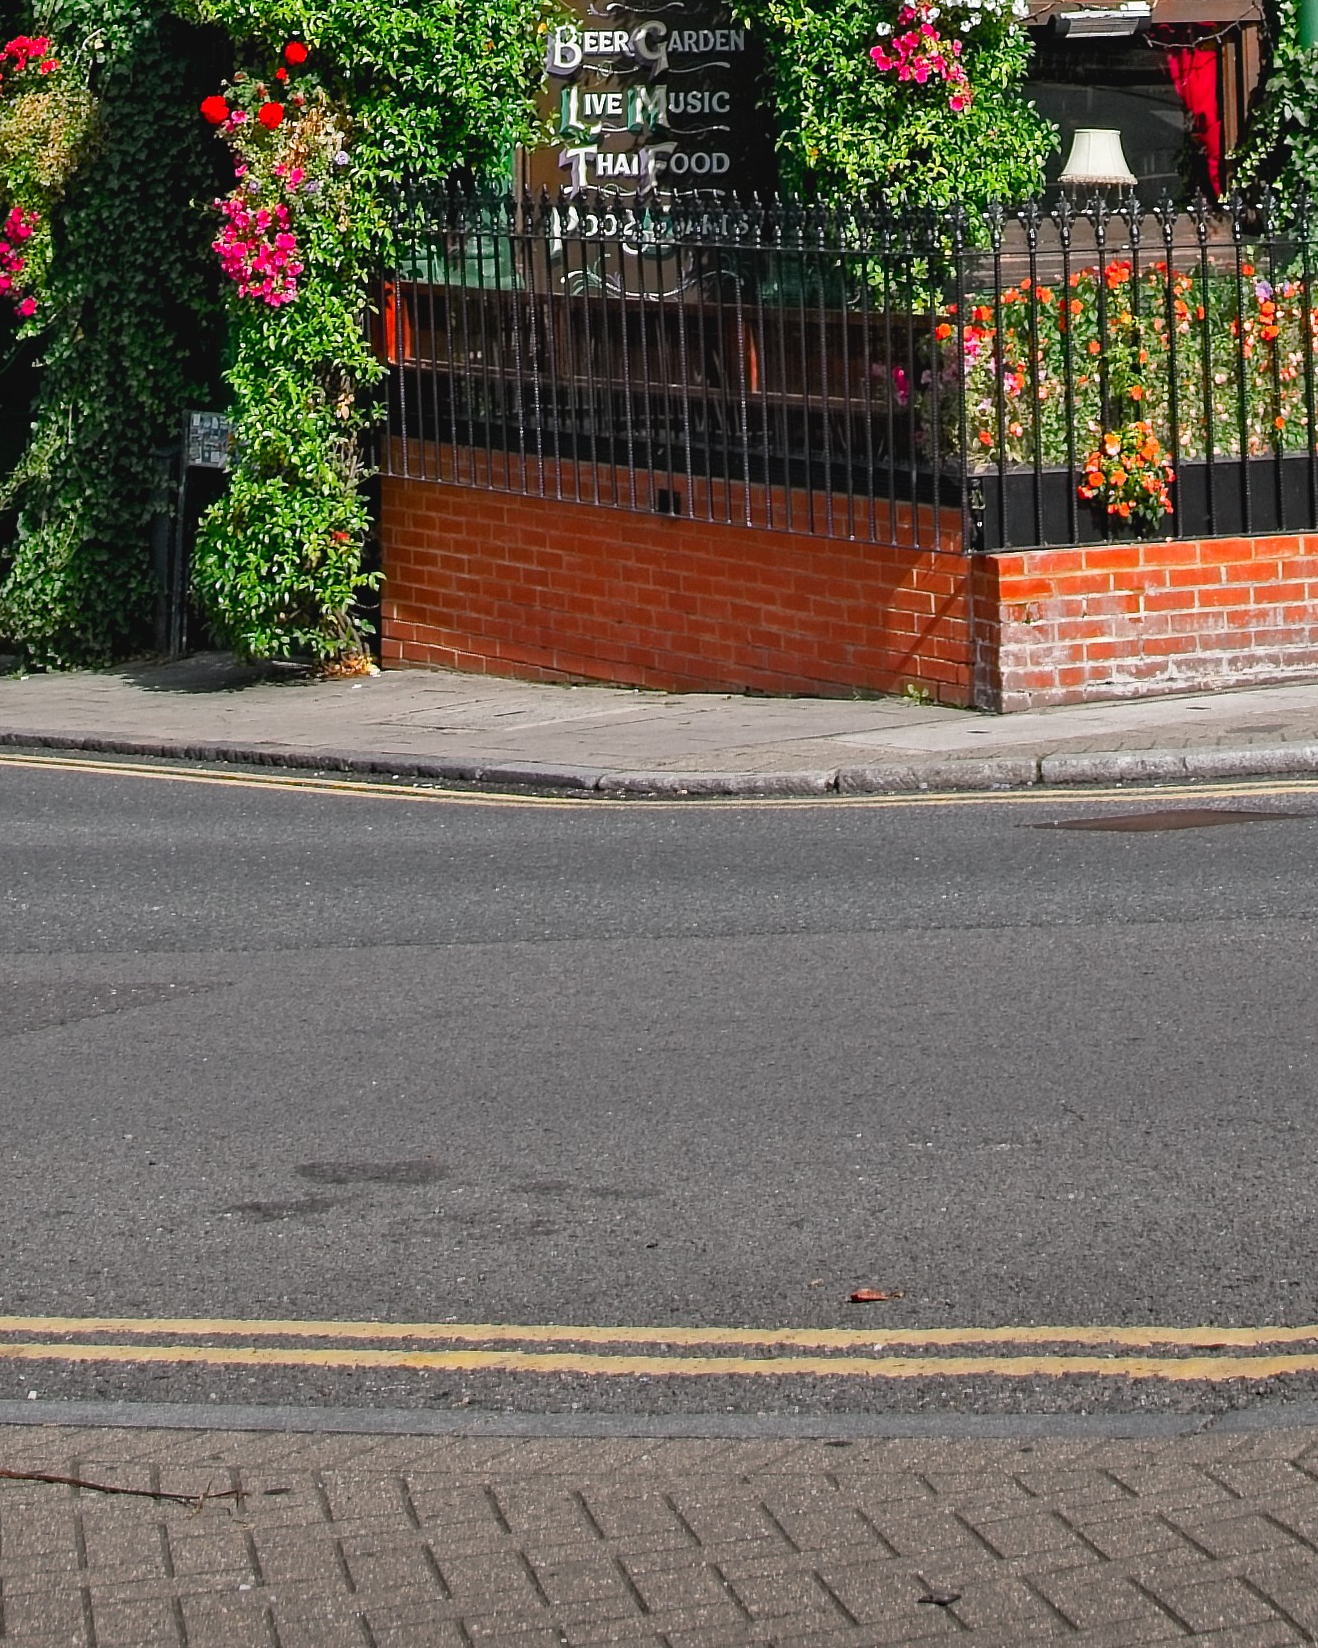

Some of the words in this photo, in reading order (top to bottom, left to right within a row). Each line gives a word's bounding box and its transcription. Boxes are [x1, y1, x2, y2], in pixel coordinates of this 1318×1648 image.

[550, 24, 634, 71] BEER
[632, 20, 745, 77] GARDEN
[562, 85, 623, 135] LIVE
[629, 84, 730, 129] MUSIC
[560, 143, 640, 188] THAI
[641, 141, 730, 189] FOOD
